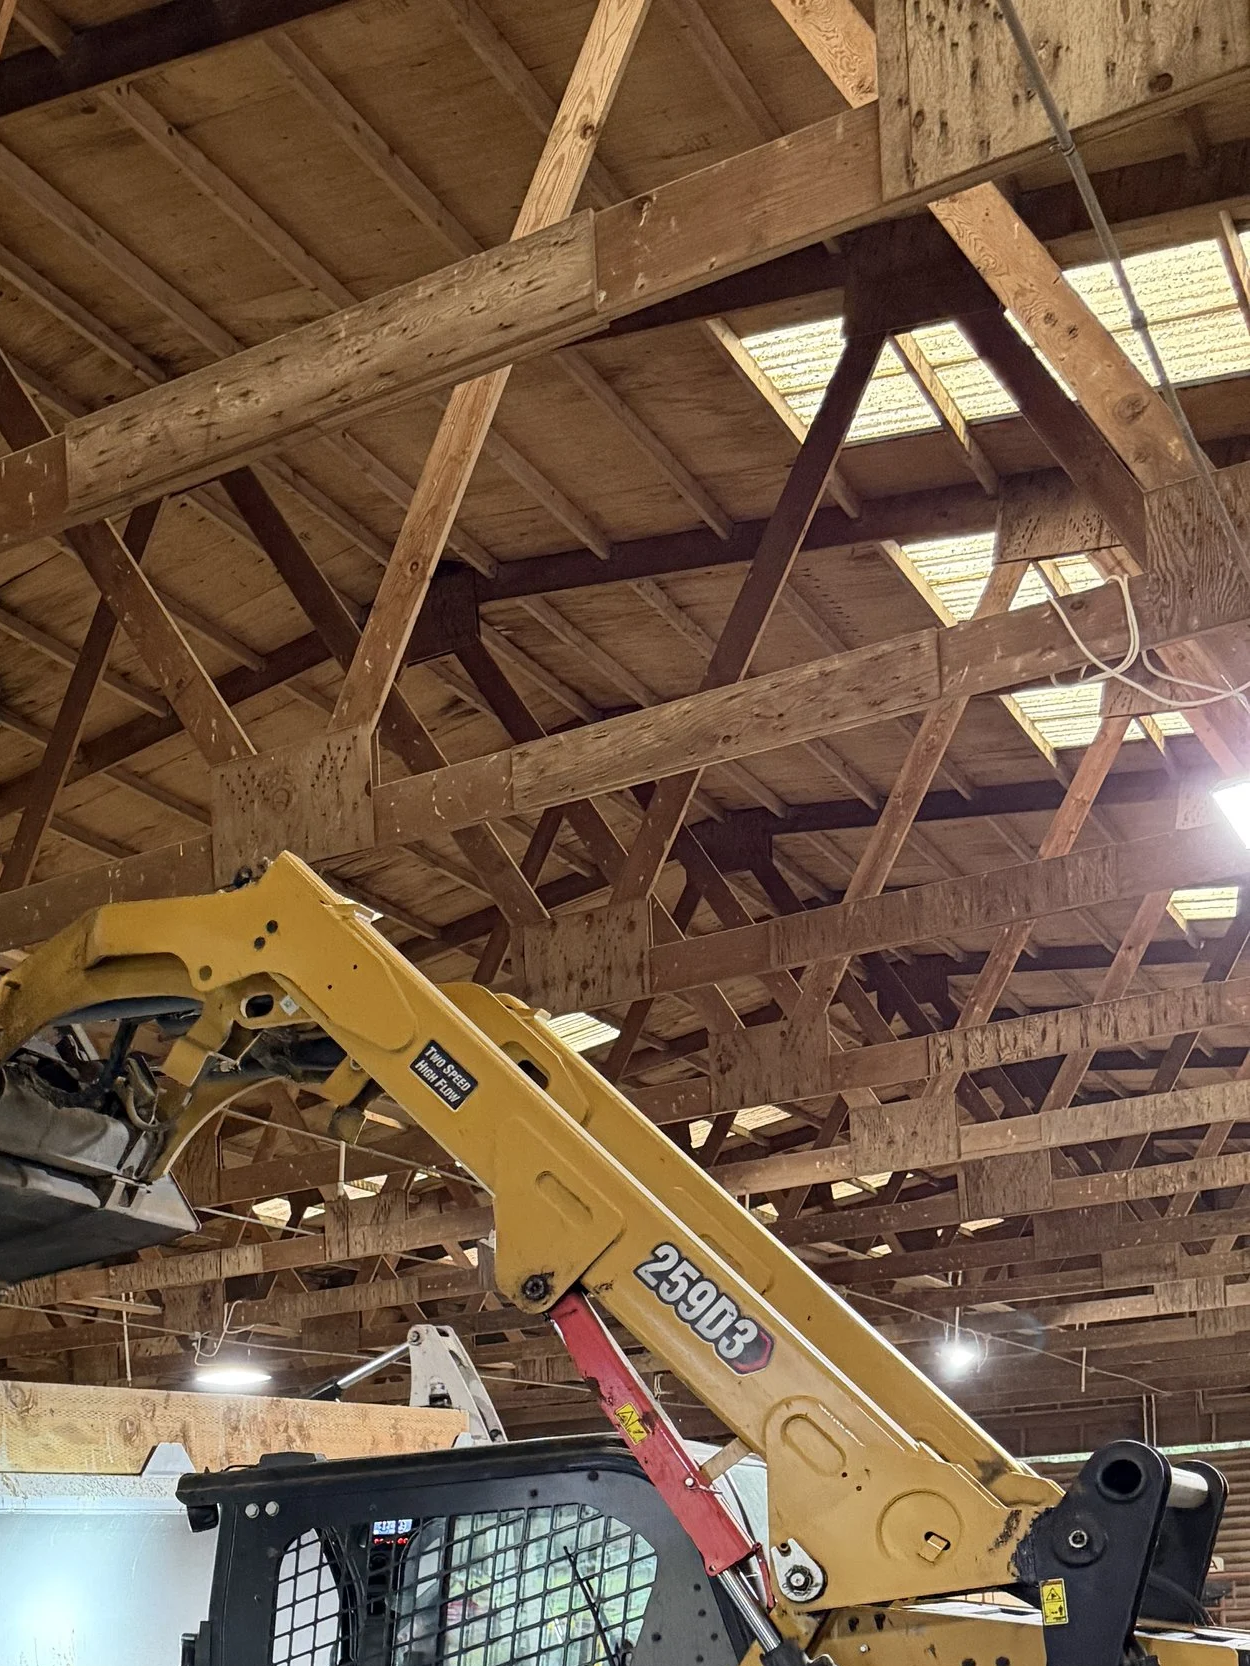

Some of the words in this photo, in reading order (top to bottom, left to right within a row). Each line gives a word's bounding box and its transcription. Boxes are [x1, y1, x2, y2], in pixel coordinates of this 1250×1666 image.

[414, 1059, 439, 1083] HIGH
[433, 1078, 461, 1103] FLOW
[424, 1046, 446, 1068] TWO
[442, 1064, 471, 1092] SPEED
[637, 1244, 758, 1359] 259D3
